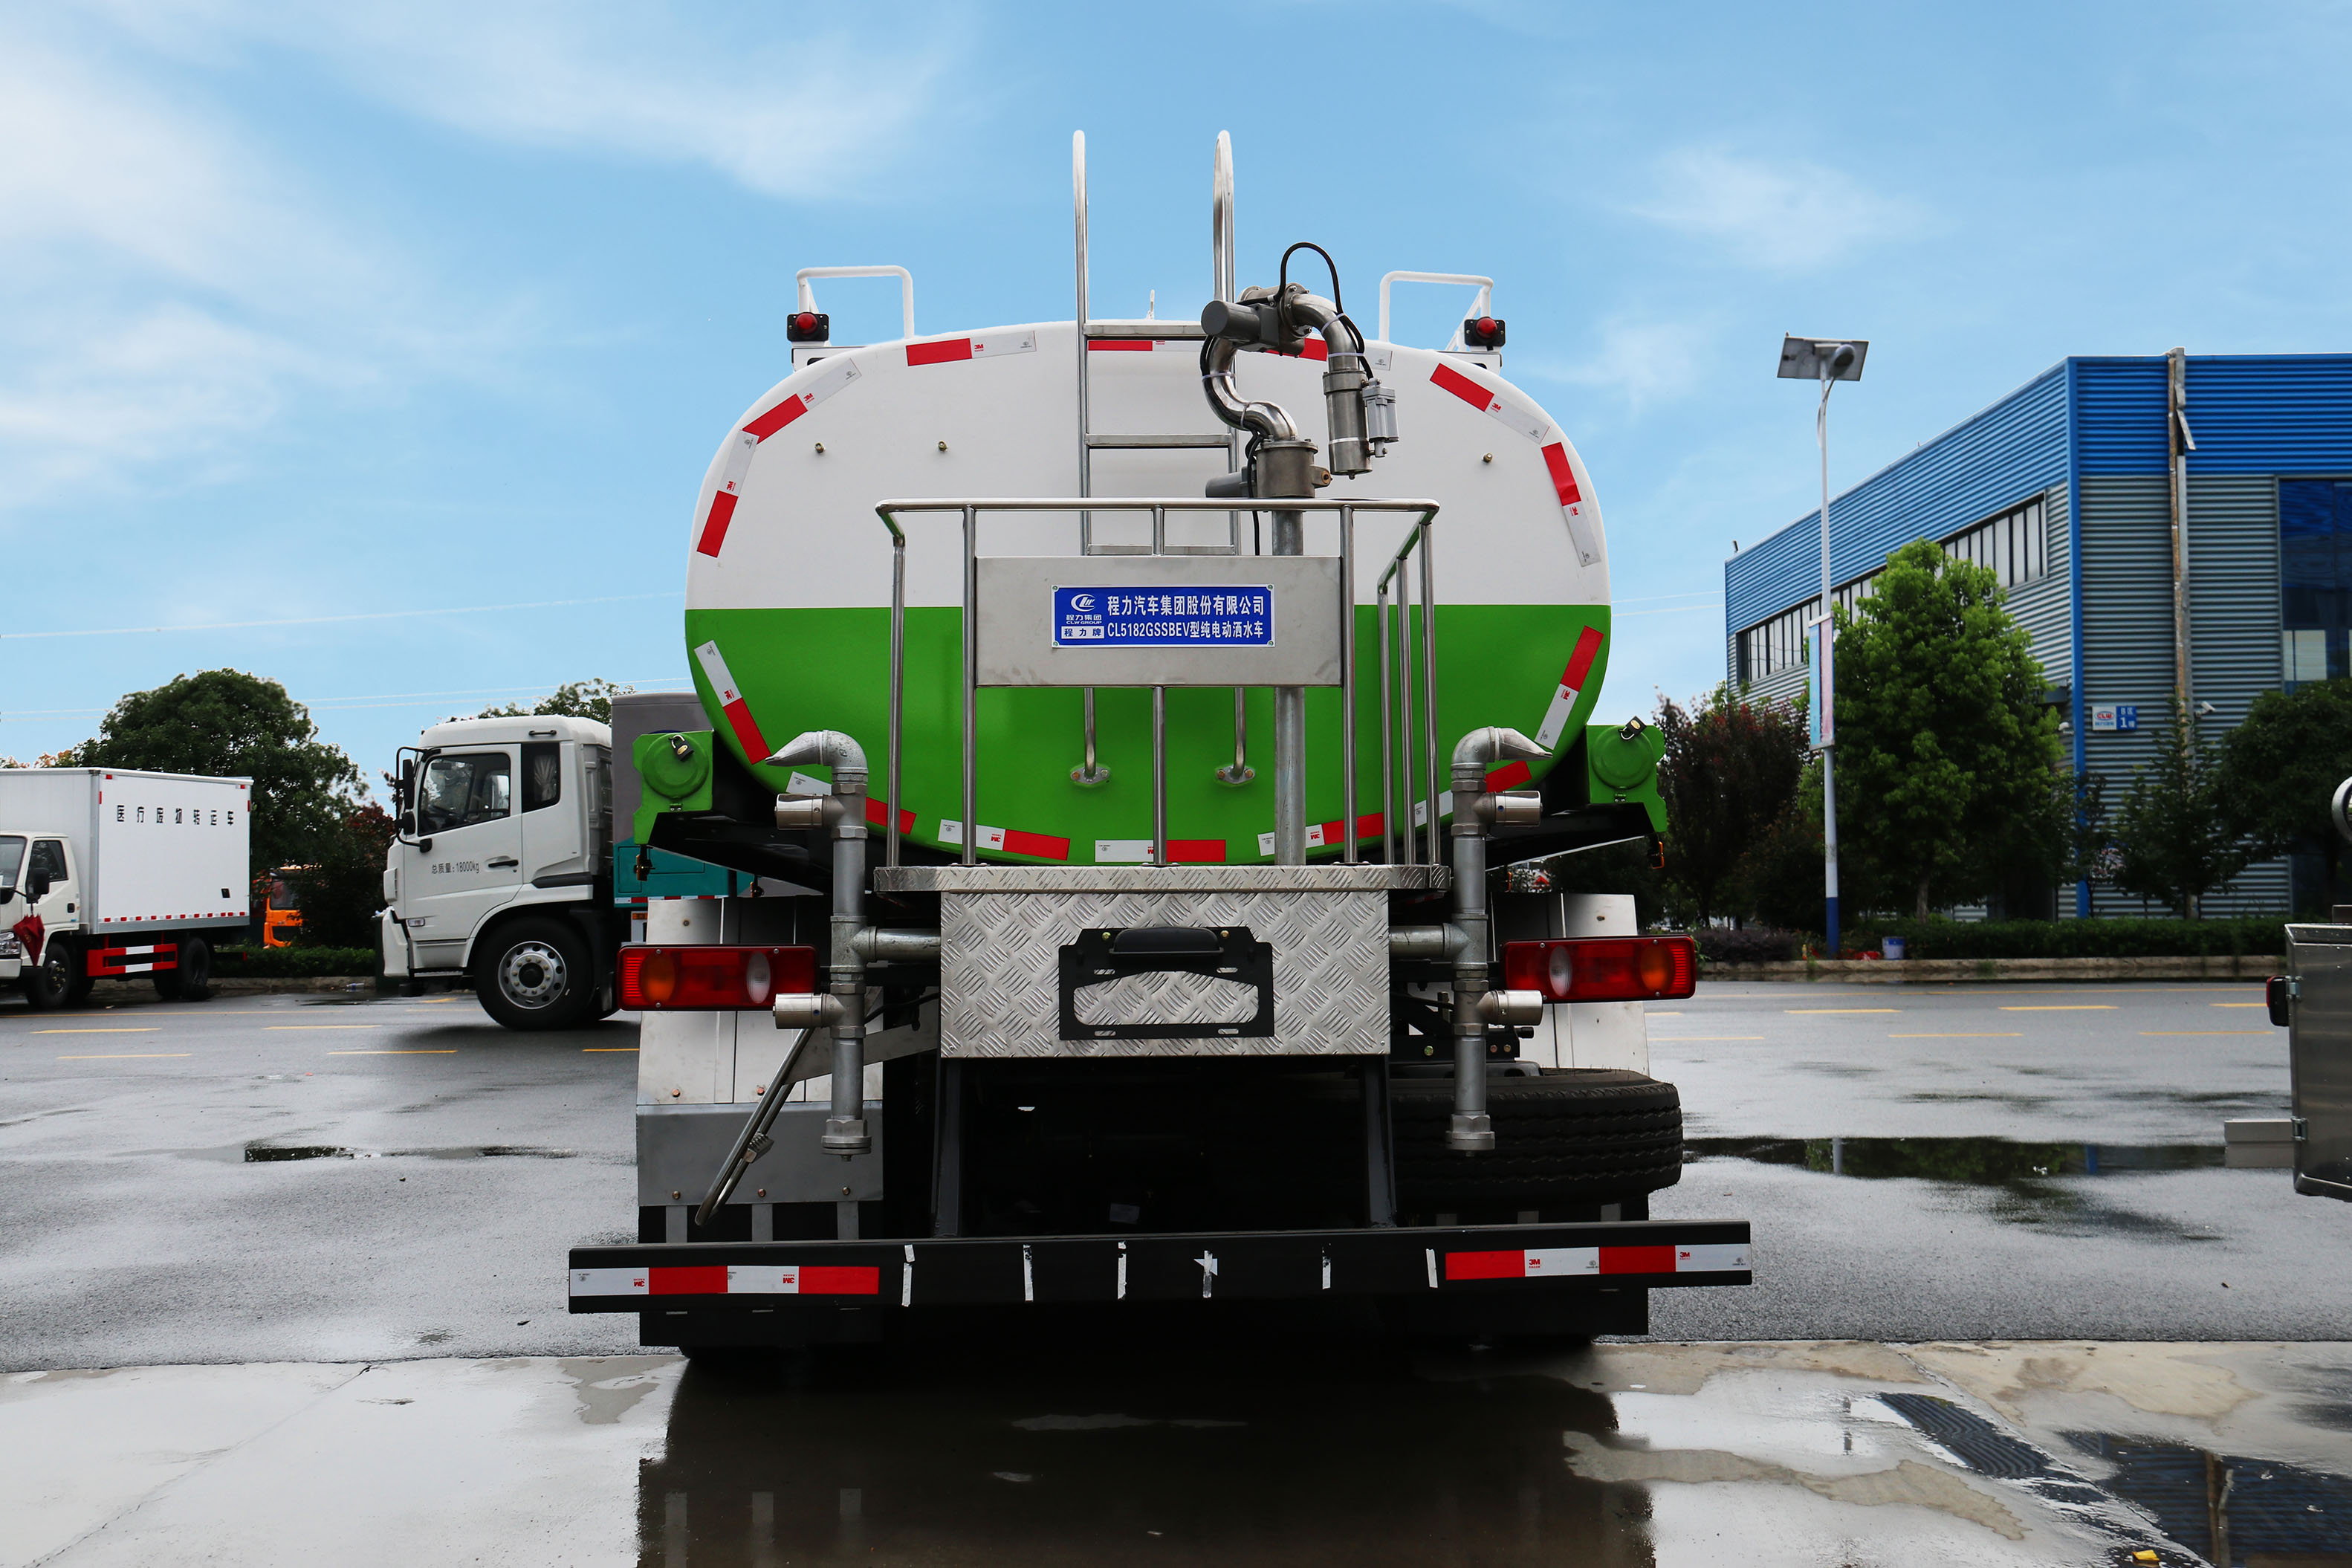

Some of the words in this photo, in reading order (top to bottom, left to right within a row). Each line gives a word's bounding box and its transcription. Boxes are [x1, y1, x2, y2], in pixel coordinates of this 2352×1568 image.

[803, 392, 814, 402] 3M
[1491, 402, 1502, 411] 3M
[726, 481, 734, 490] 3M
[1571, 506, 1579, 516] 3M
[1107, 595, 1264, 616] 程力汽车集团股份有限公司
[1064, 628, 1101, 637] 程力牌
[1107, 621, 1263, 638] CL5182GSSBEV型纯电动洒水车
[724, 690, 733, 699] 3M
[1562, 690, 1570, 701] 3M
